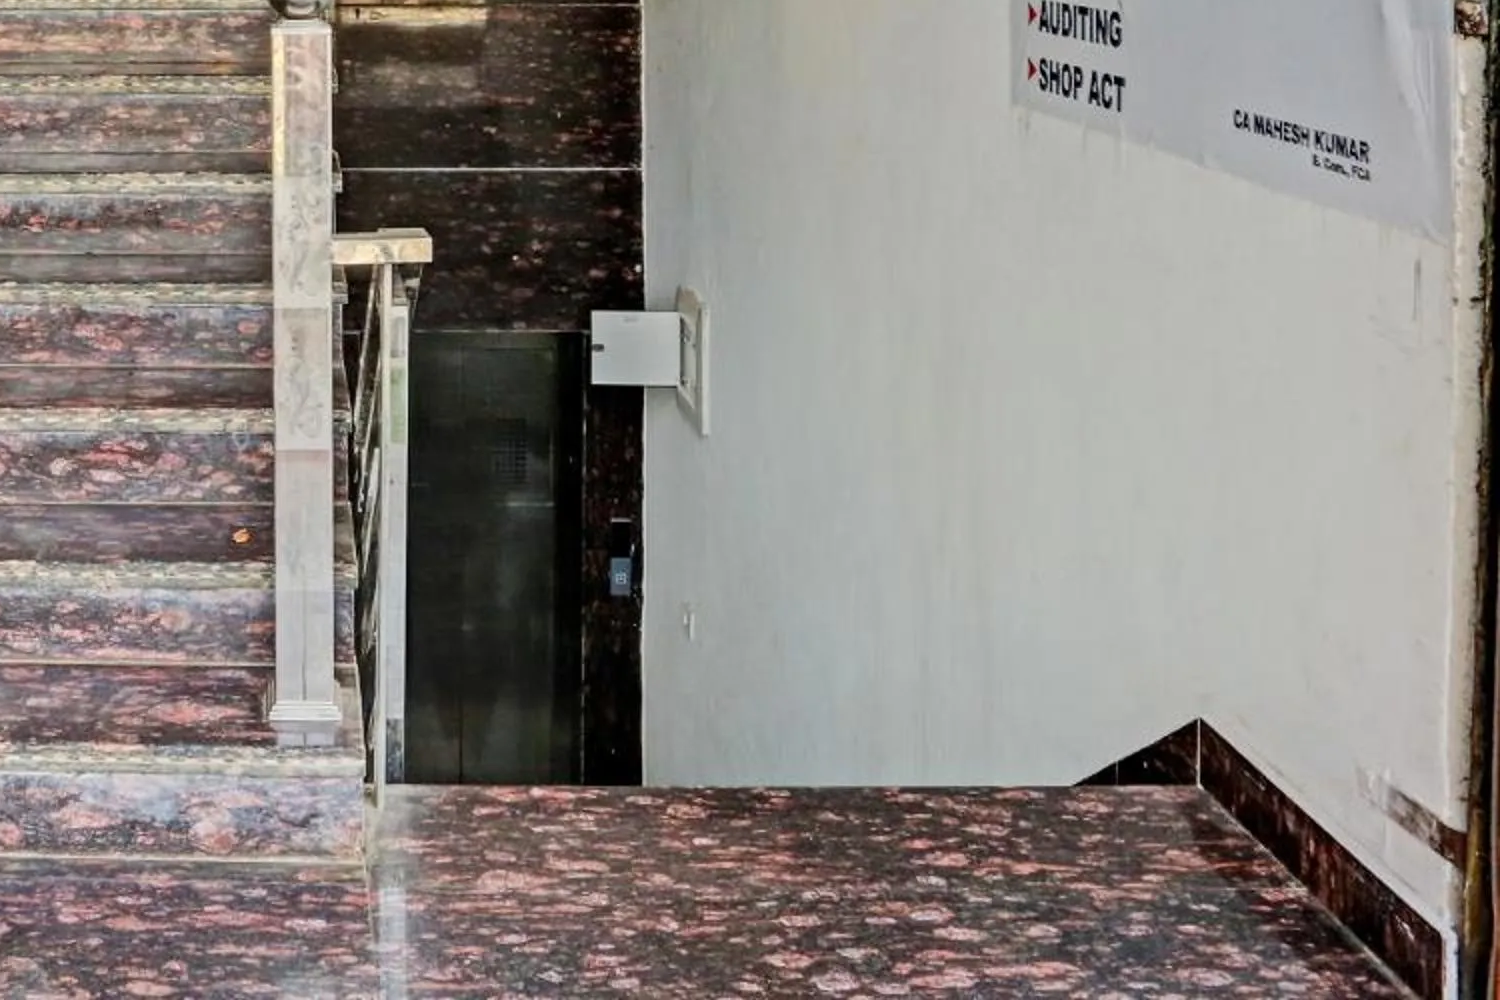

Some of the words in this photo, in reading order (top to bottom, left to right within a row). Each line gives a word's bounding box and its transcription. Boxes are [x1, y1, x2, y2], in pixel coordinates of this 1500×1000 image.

[1039, 0, 1123, 48] AUDITING
[1039, 58, 1084, 101] SHOP
[1088, 70, 1126, 113] ACT
[1233, 109, 1250, 132] CA
[1254, 113, 1310, 149] MAHESH
[1314, 130, 1371, 164] KUMAR
